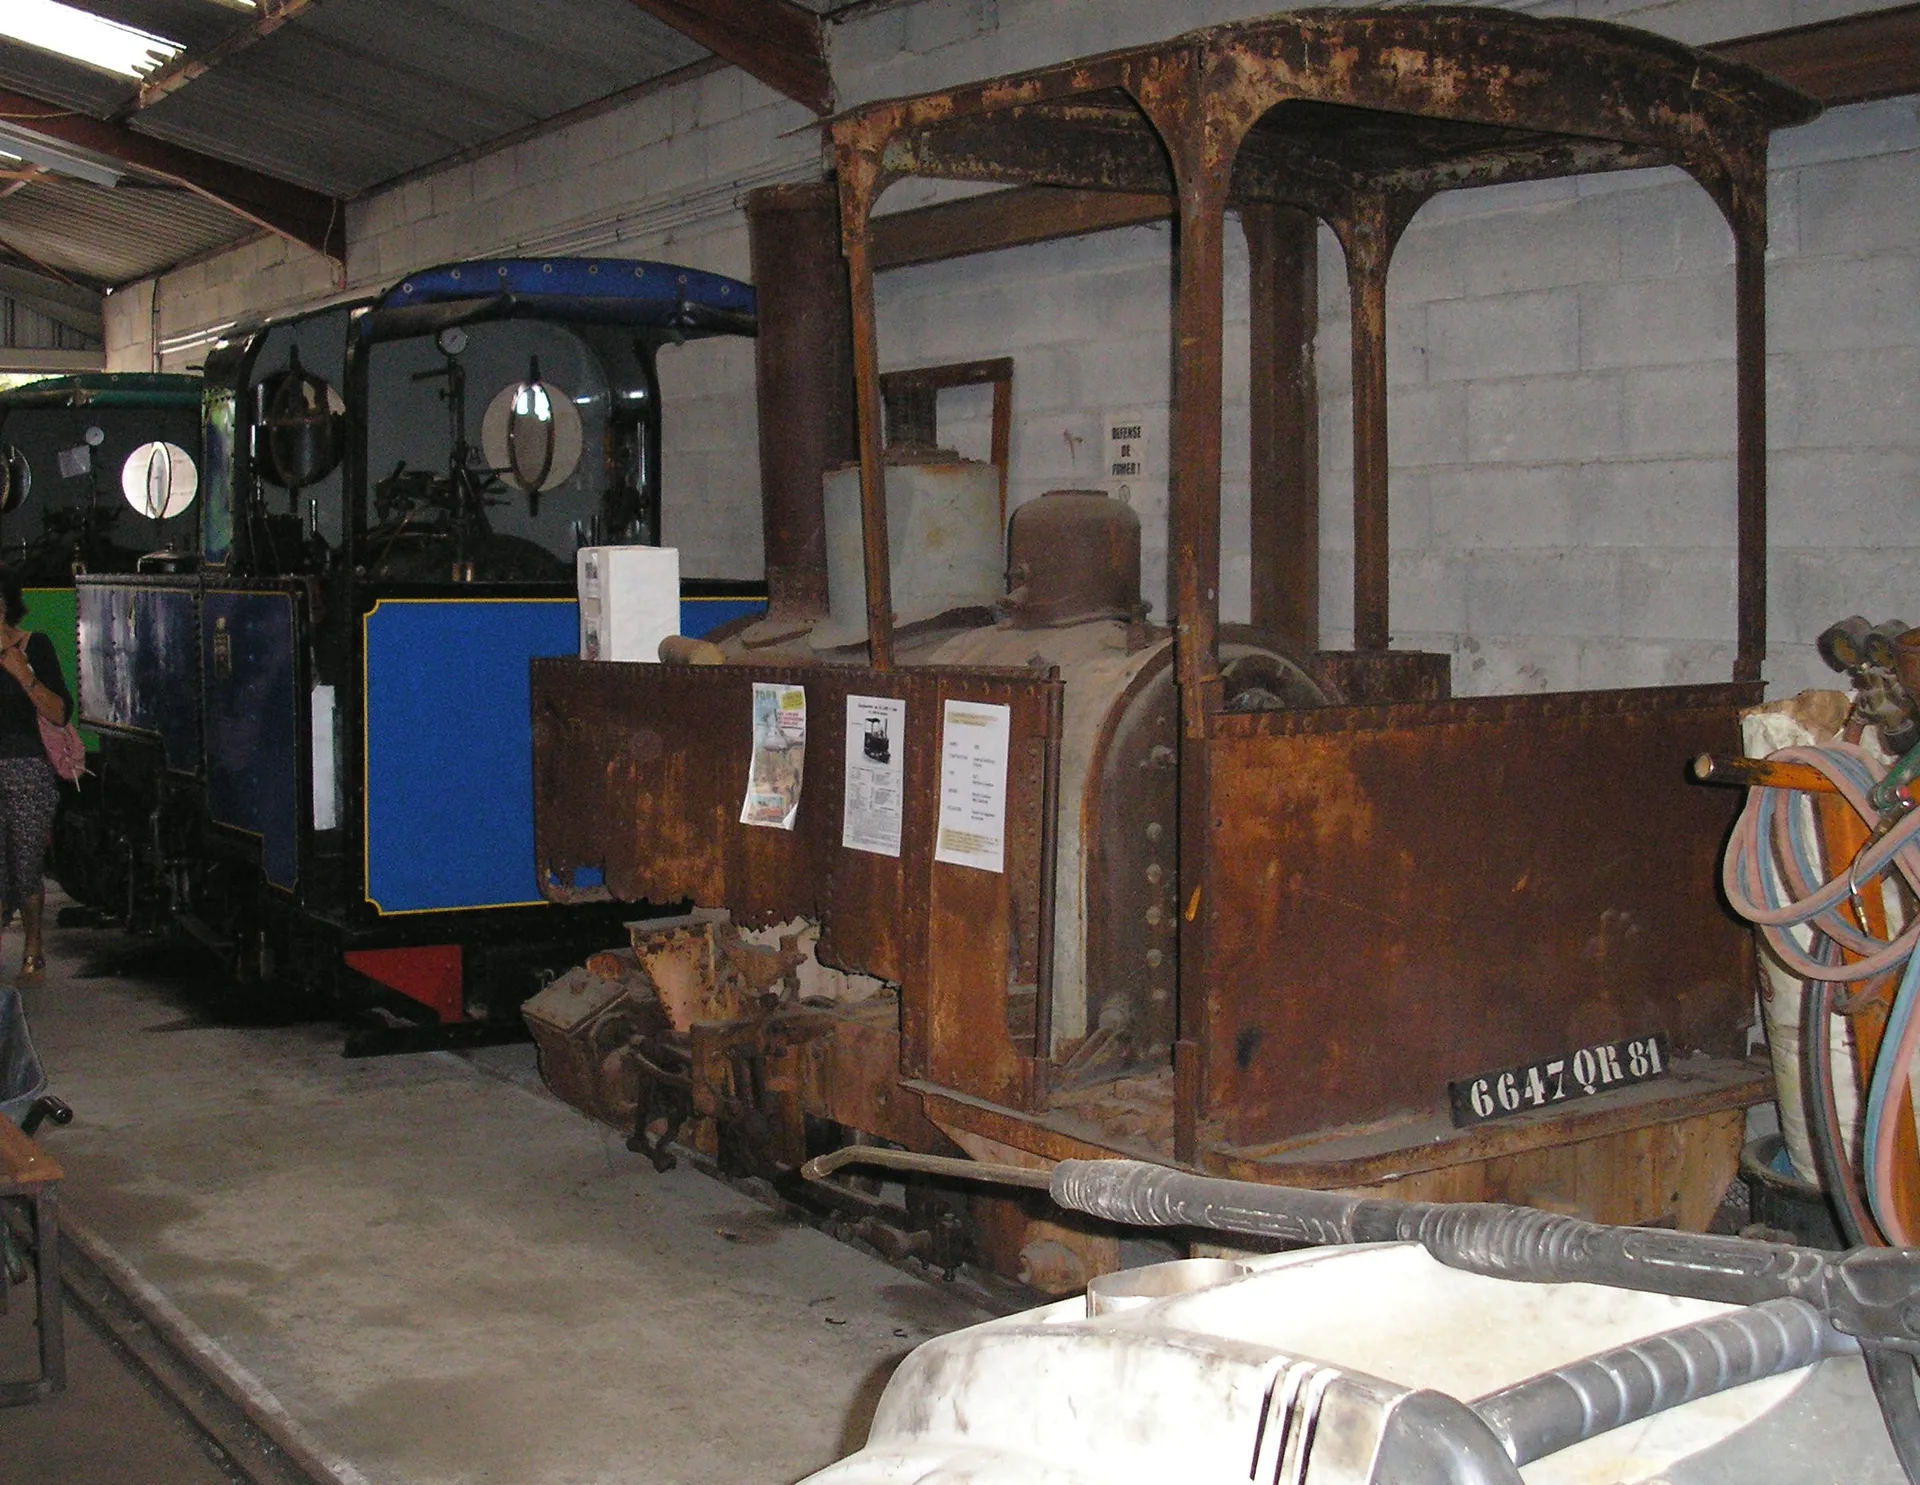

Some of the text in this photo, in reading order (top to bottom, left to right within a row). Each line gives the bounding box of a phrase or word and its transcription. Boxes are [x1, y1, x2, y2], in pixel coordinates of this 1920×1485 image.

[1121, 445, 1131, 457] DE
[1471, 1038, 1662, 1117] 6647 QR 81
